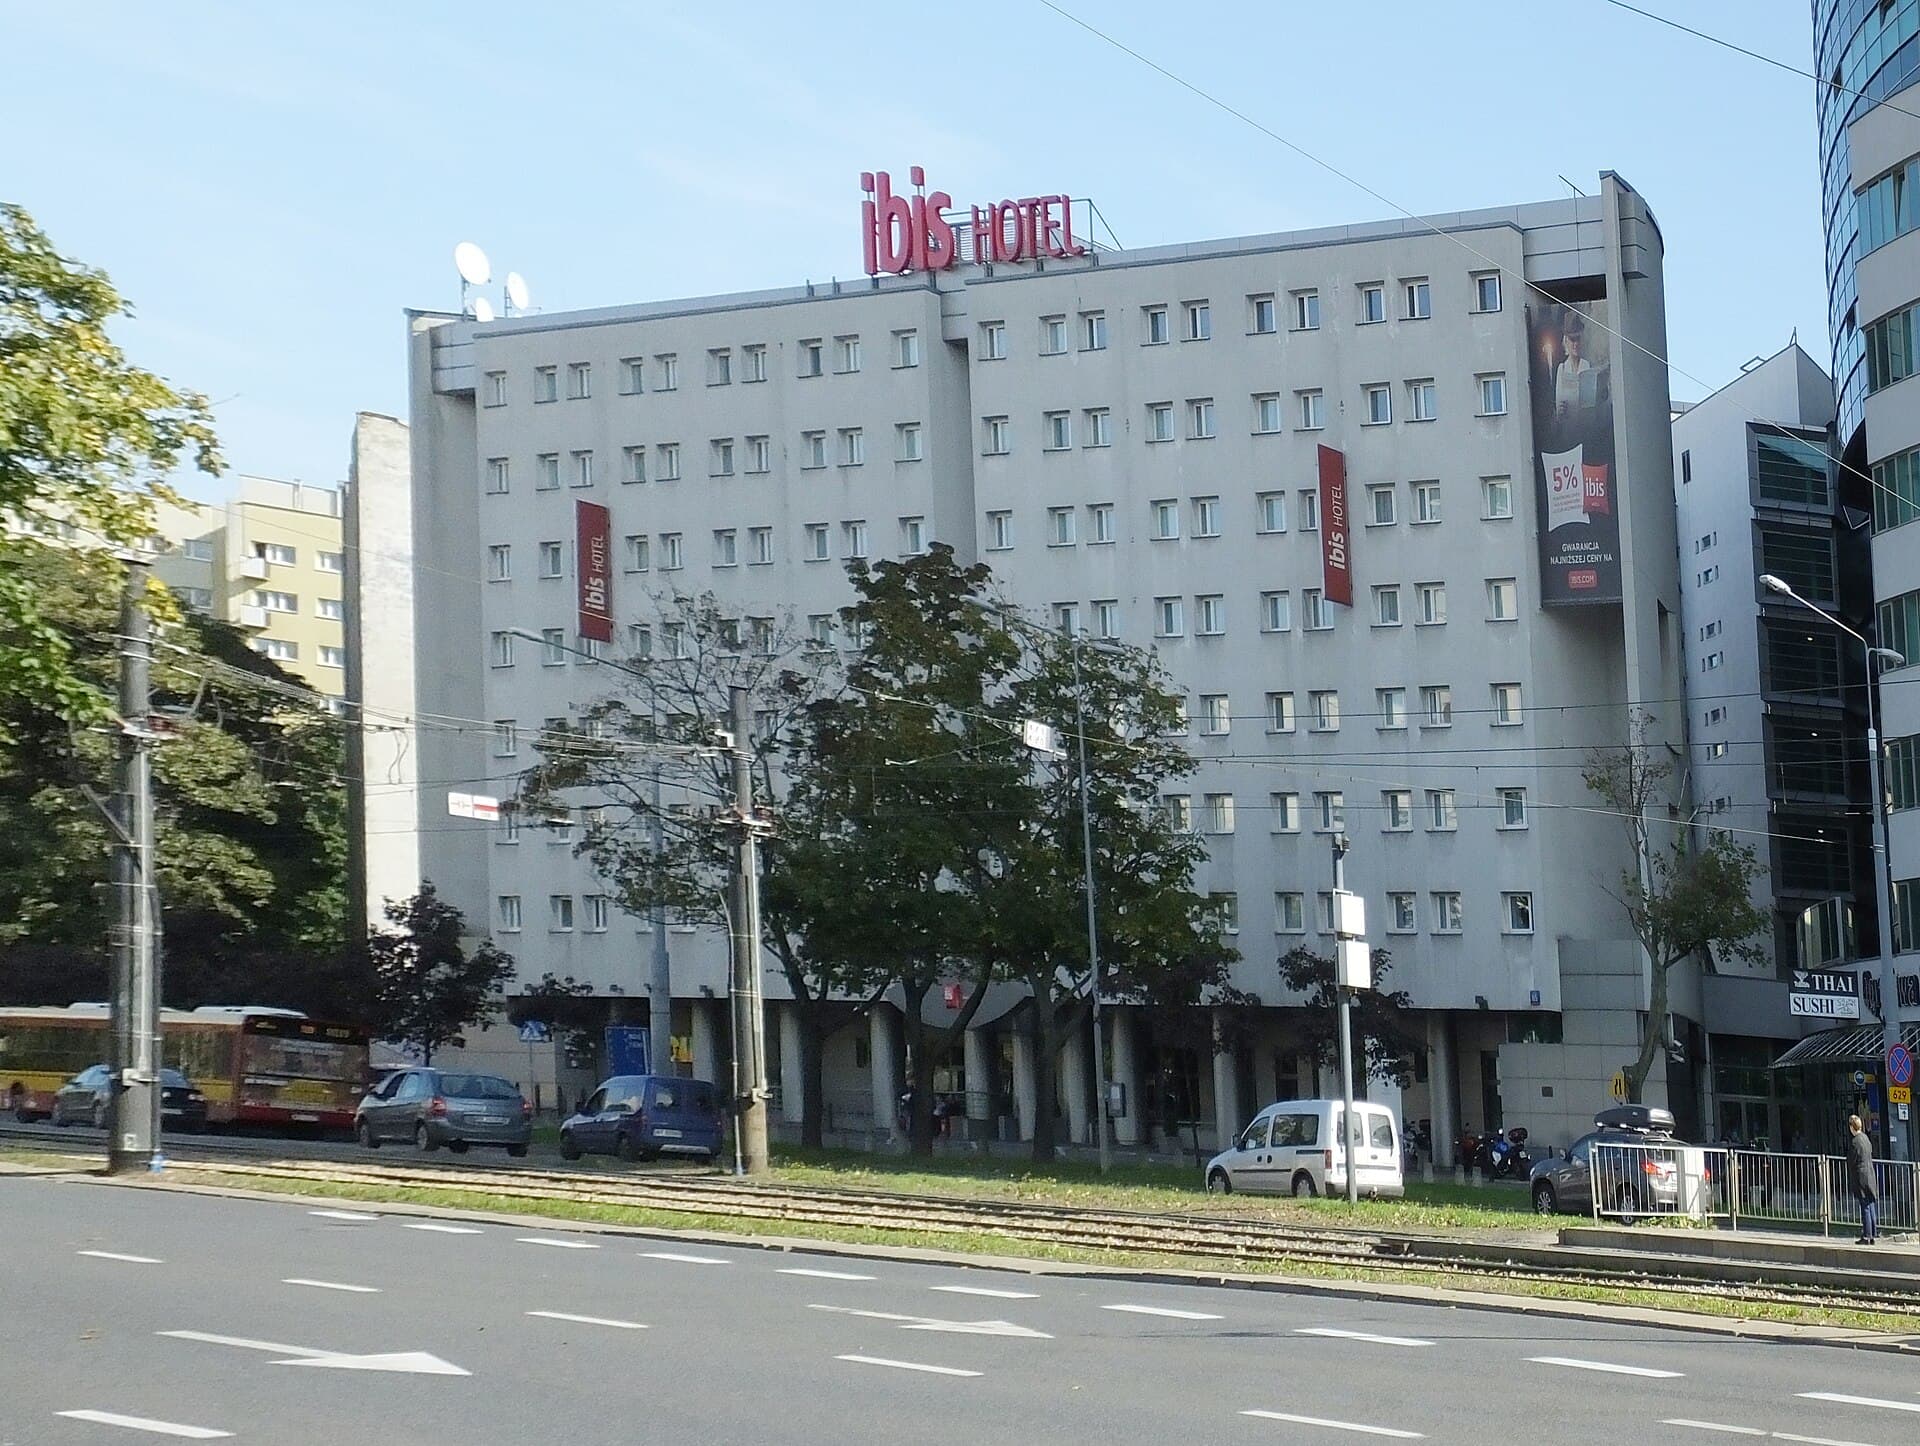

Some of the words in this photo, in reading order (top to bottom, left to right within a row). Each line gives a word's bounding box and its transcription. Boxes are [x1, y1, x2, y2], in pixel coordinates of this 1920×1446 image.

[861, 166, 955, 276] ibis
[970, 194, 1085, 265] HOTEL
[1552, 463, 1578, 492] 5%
[1585, 477, 1605, 497] ibis
[1331, 484, 1343, 527] HOTEL
[591, 535, 605, 573] HOTEL
[1328, 531, 1345, 570] ibis
[1561, 541, 1600, 552] GWARANCJA
[1586, 553, 1603, 563] CENY
[1603, 553, 1613, 562] NA
[584, 576, 605, 611] ibis
[1811, 974, 1853, 992] THAI
[1793, 997, 1834, 1014] SUSHI
